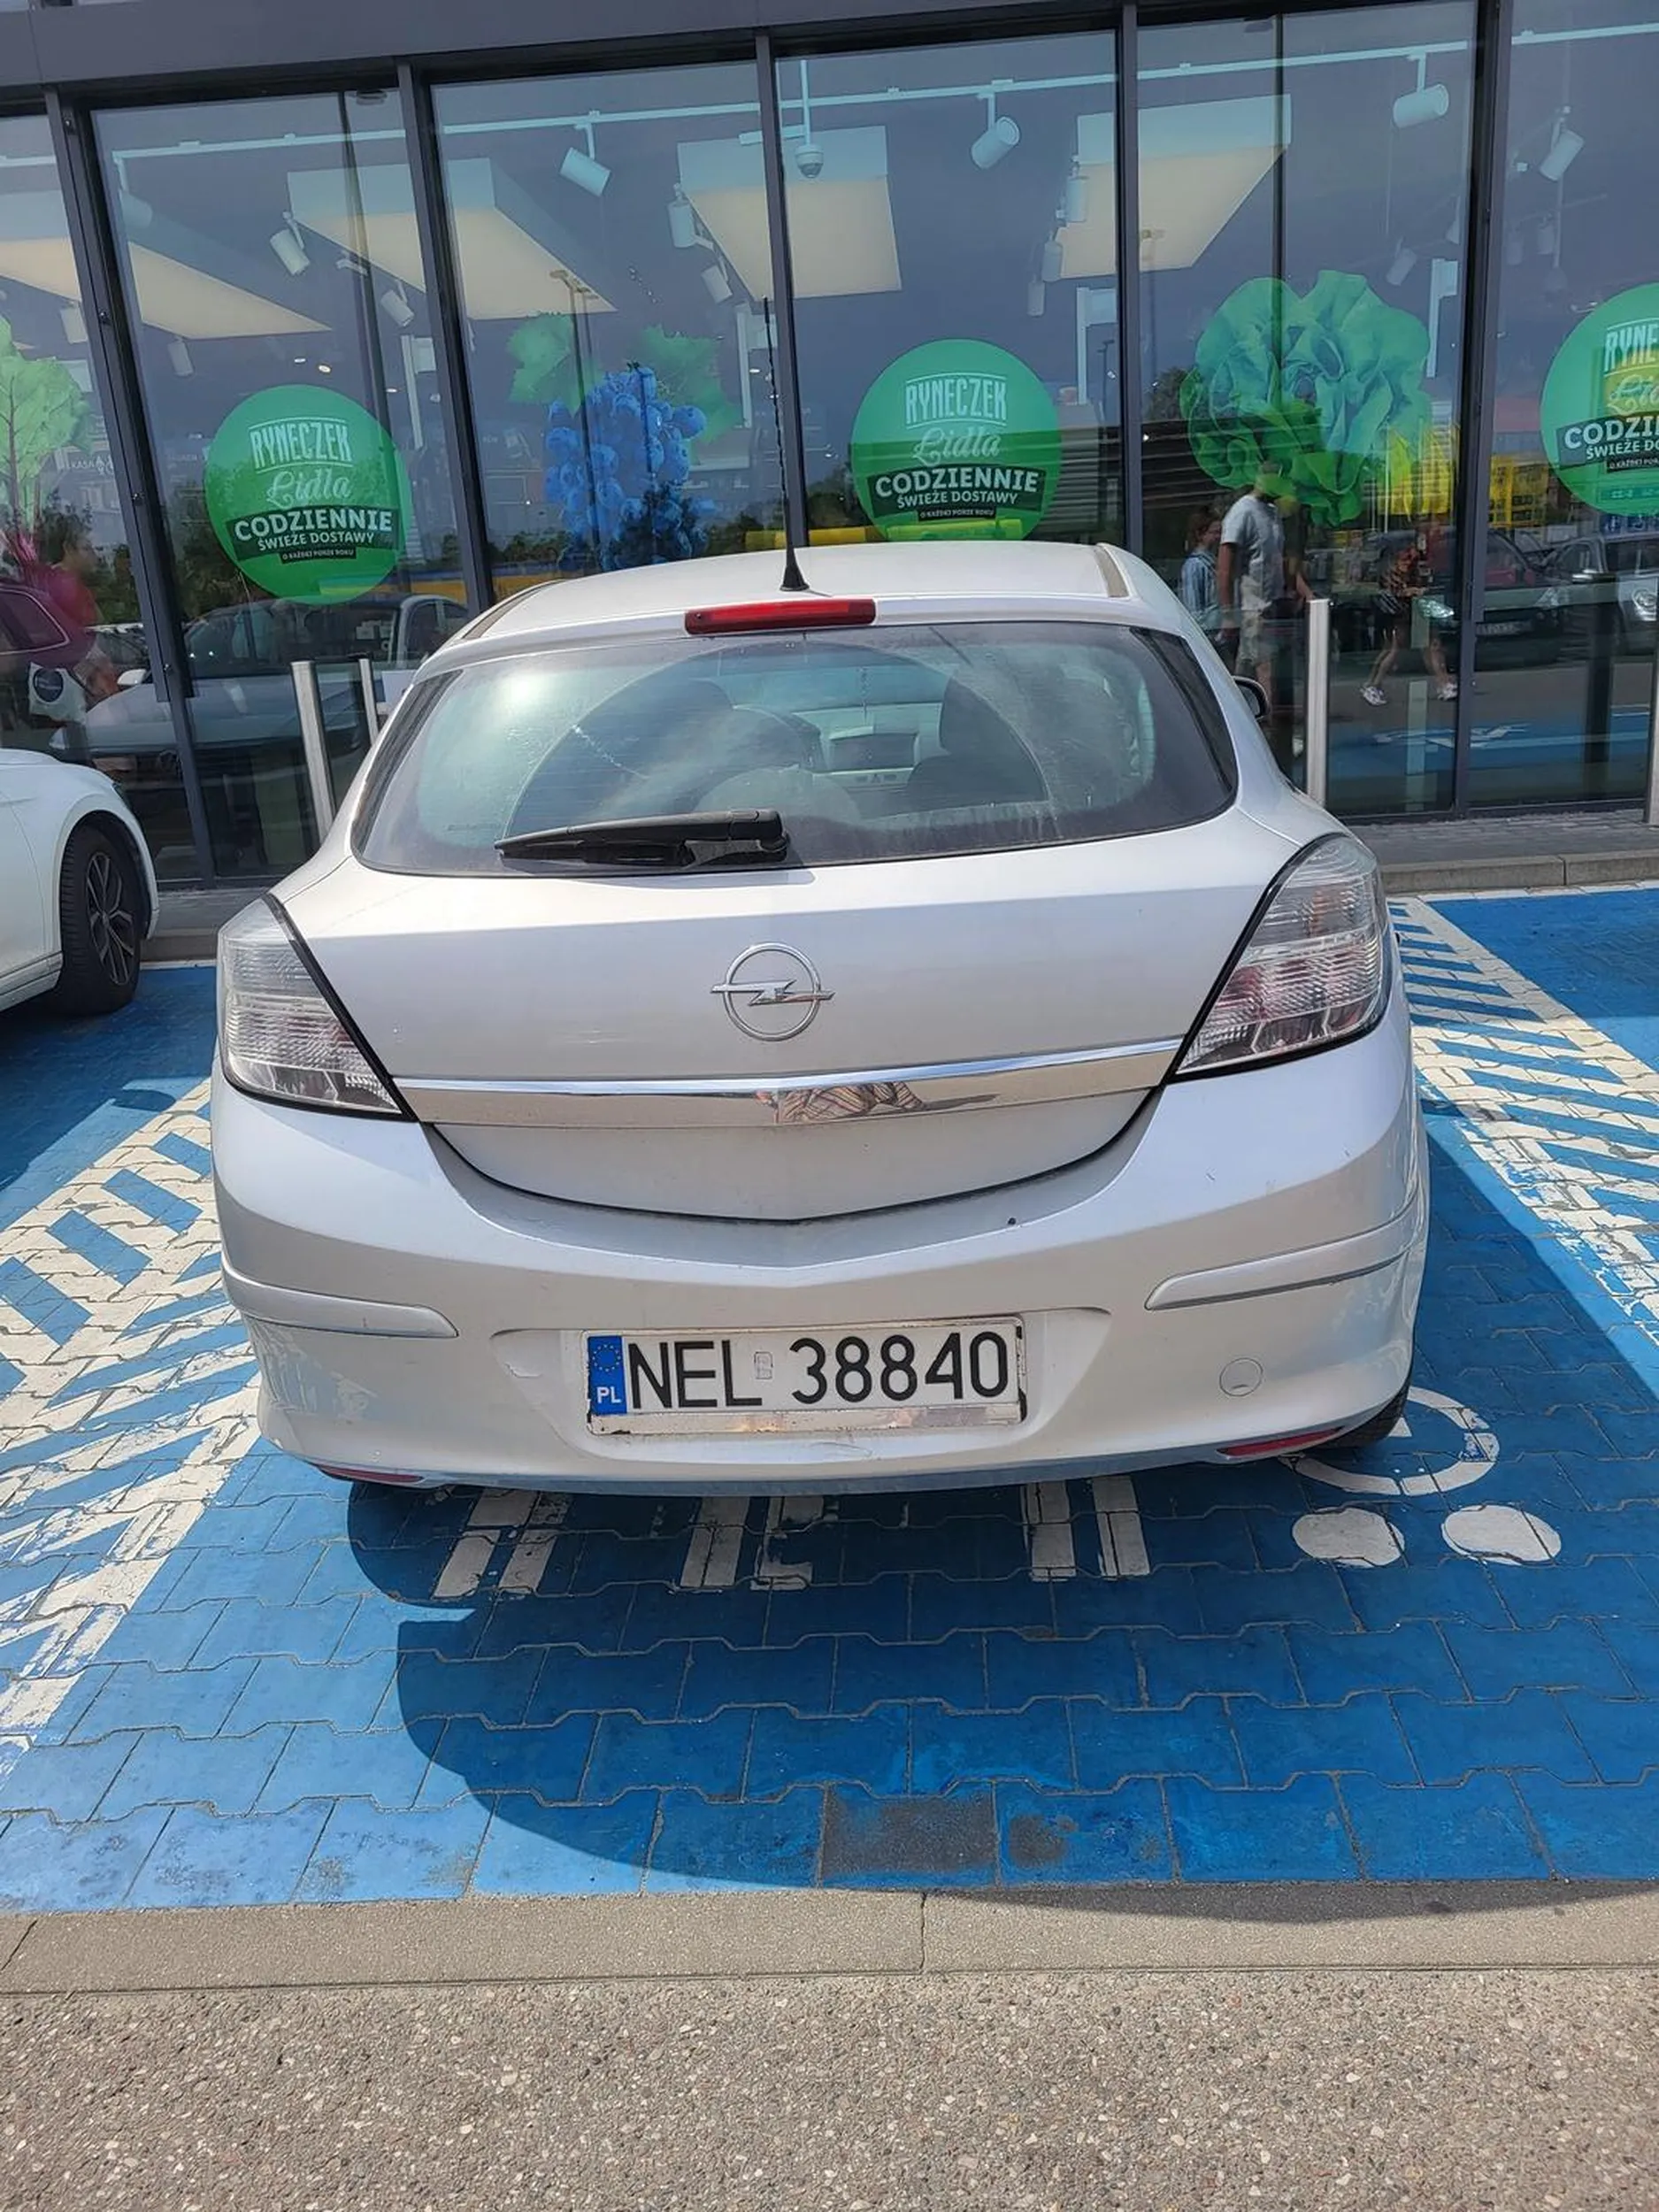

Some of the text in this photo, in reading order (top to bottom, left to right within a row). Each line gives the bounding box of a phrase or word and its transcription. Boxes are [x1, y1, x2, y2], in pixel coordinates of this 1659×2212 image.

[905, 377, 1007, 425] RYNECZEK
[250, 422, 352, 469] RYNECZEK
[911, 425, 1002, 467] Lidla
[1586, 438, 1640, 459] ŚWIEŻE
[266, 468, 352, 510] Lidla
[875, 466, 1039, 498] CODZIENNIE
[896, 489, 1018, 509] ŚWIEŻE DOSTAWY
[234, 510, 393, 541] CODZIENNIE
[257, 530, 375, 551] ŚWIEŻE DOSTAWY
[628, 1331, 1009, 1409] NEL 38840
[596, 1386, 622, 1404] PL
